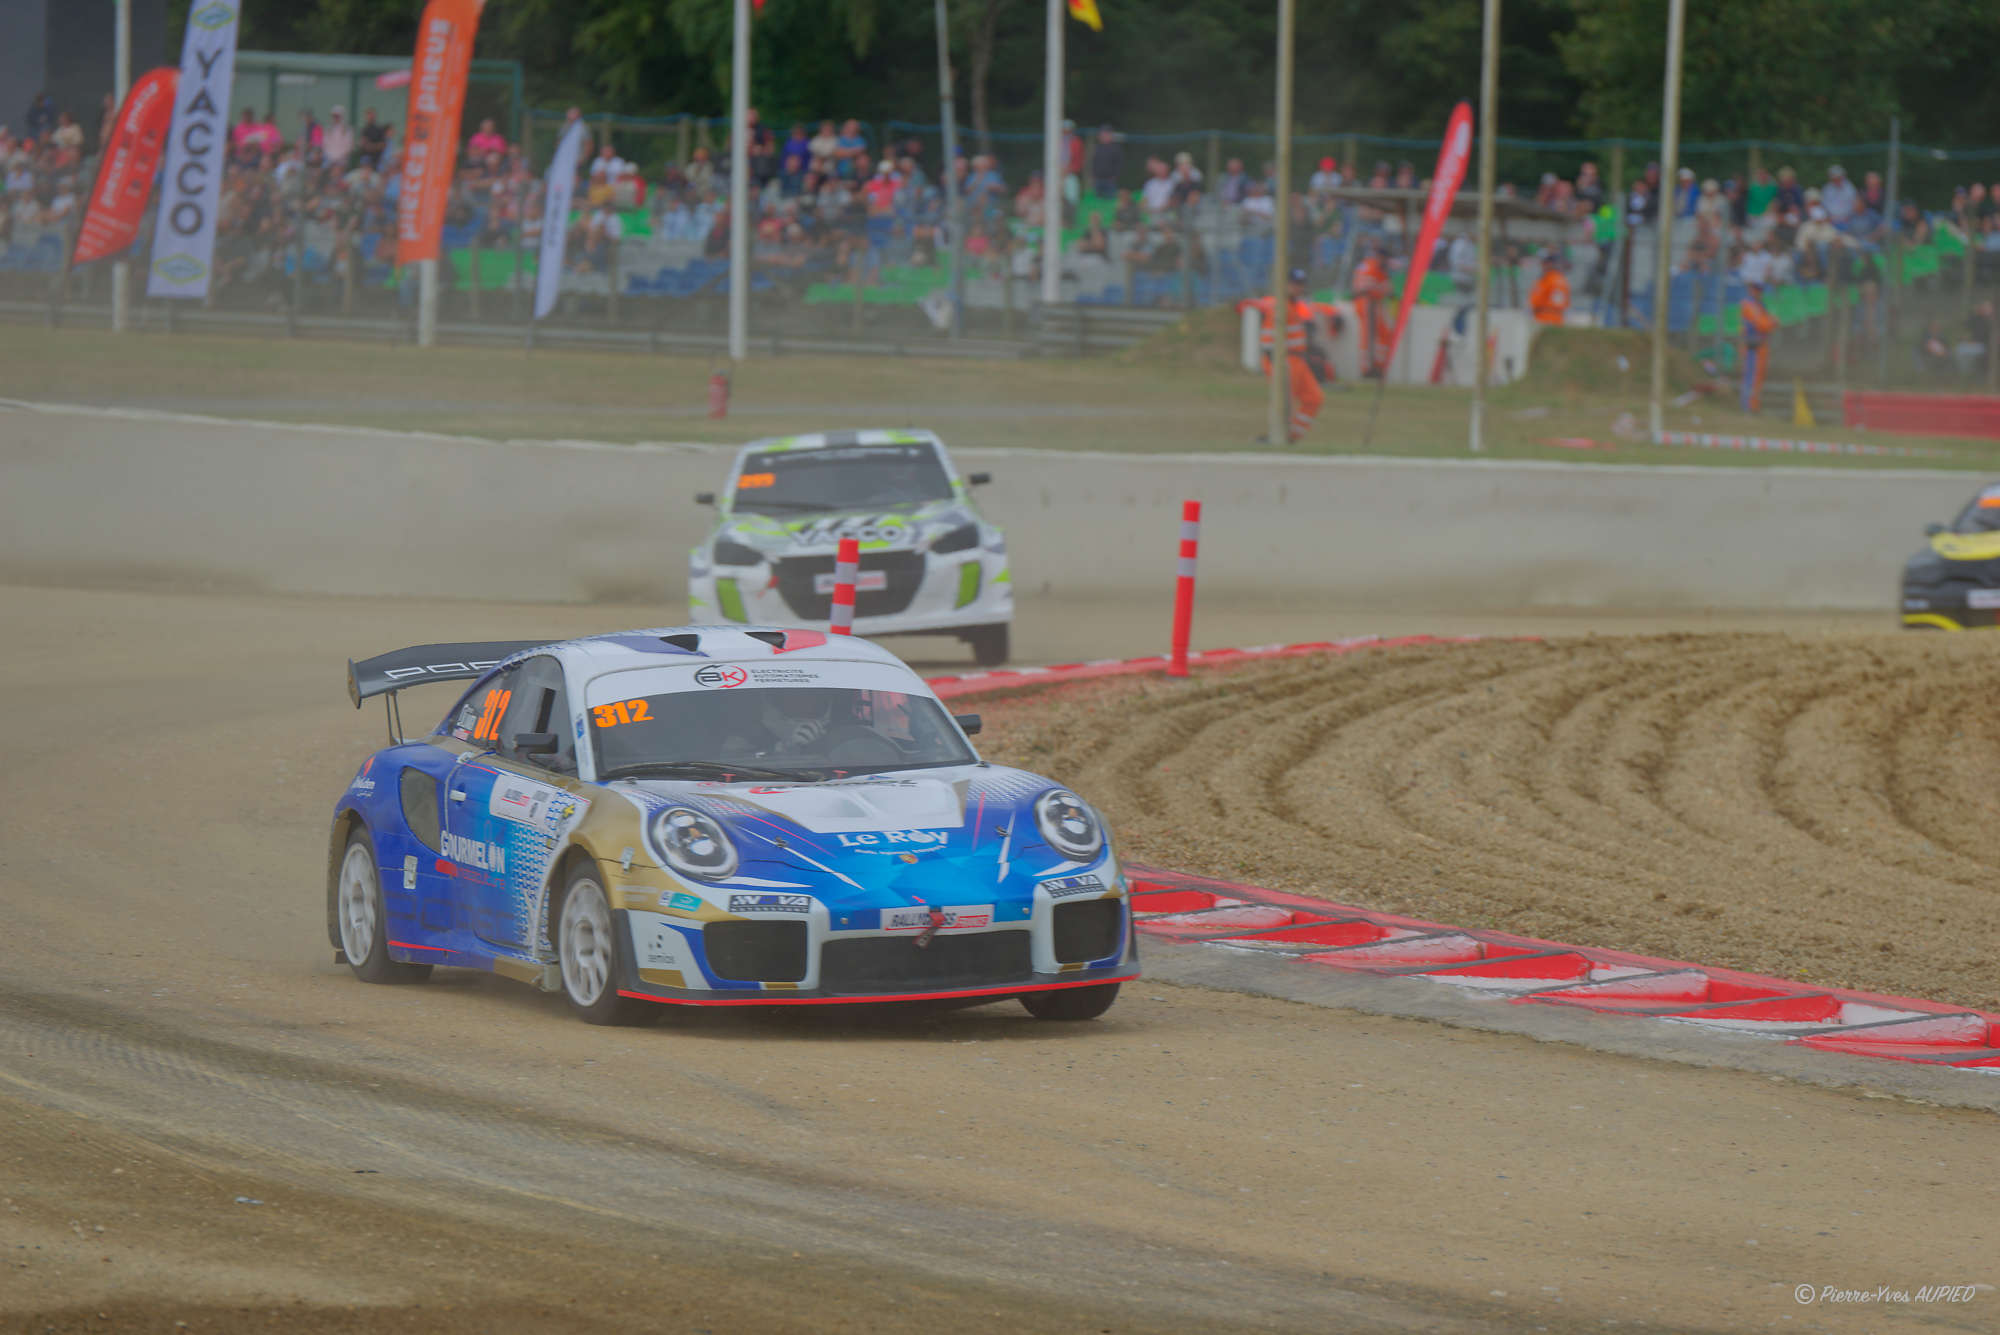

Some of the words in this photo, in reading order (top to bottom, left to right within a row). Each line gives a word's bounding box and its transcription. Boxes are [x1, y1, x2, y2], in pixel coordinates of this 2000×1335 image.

[417, 18, 450, 112] pneus
[170, 48, 222, 236] YACCO
[473, 689, 512, 740] 312
[593, 699, 654, 728] 312
